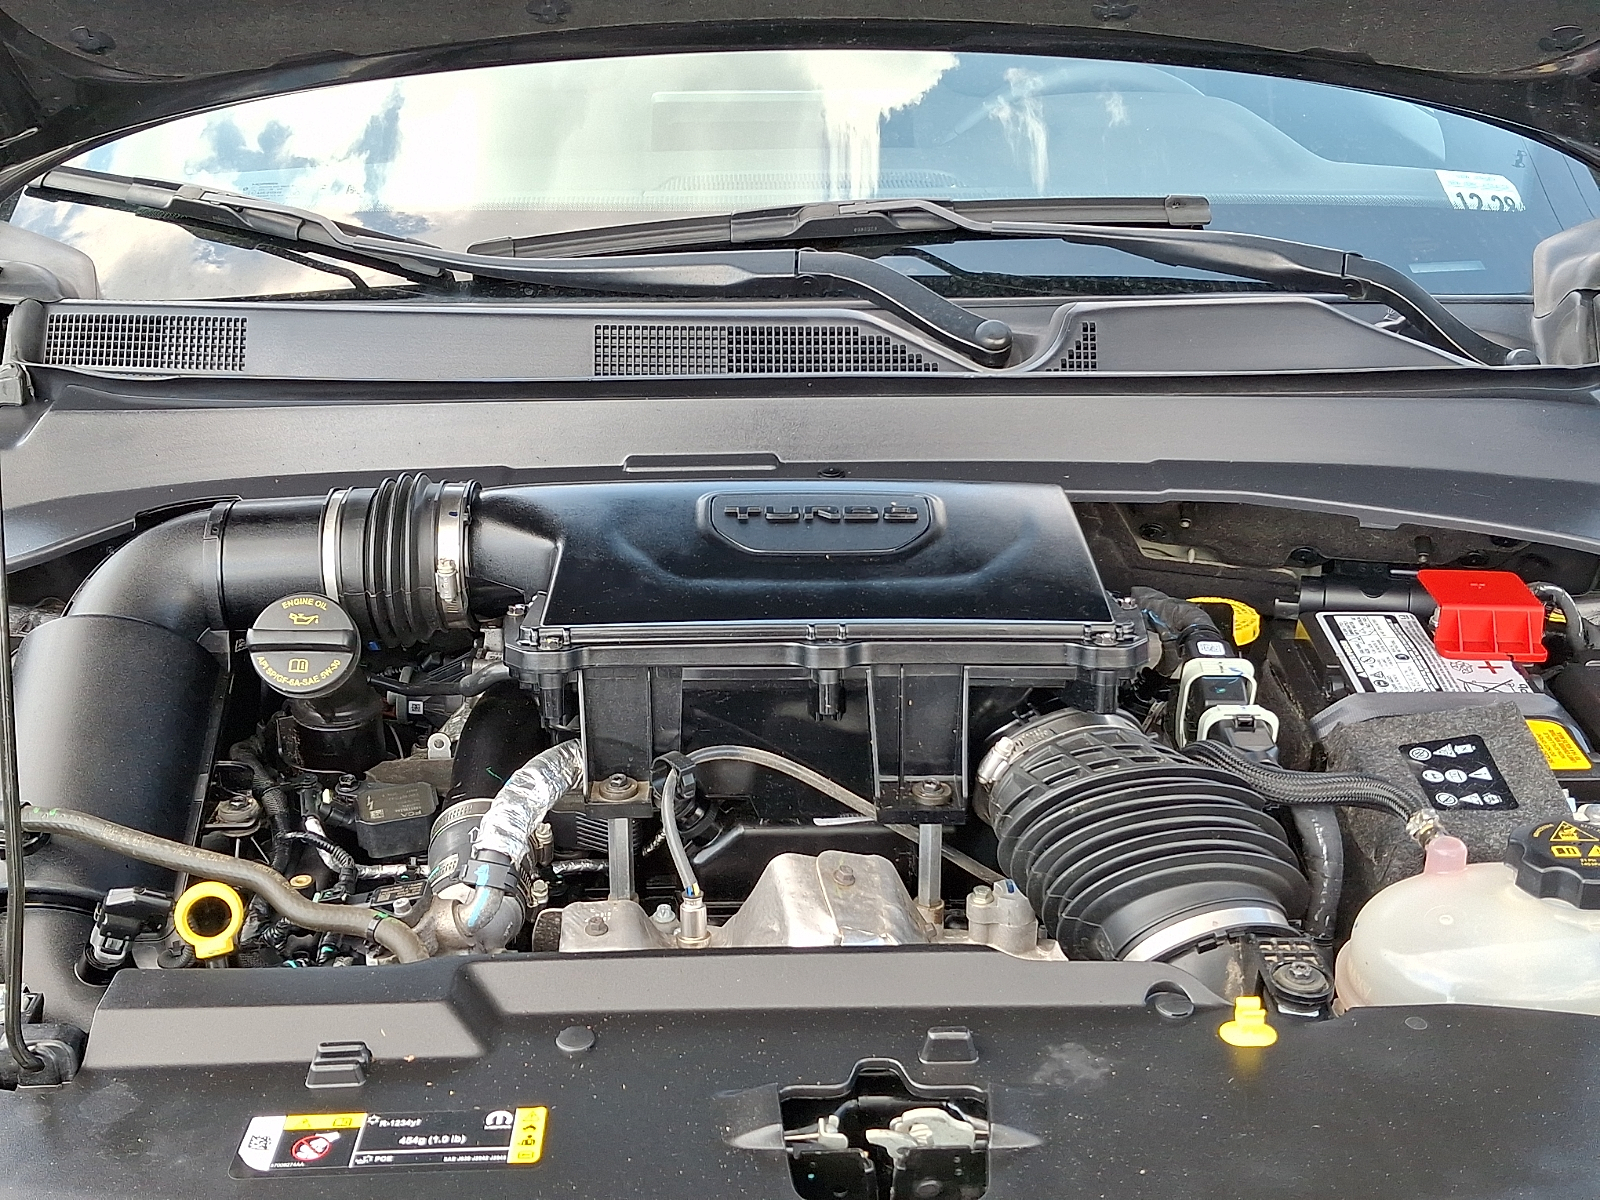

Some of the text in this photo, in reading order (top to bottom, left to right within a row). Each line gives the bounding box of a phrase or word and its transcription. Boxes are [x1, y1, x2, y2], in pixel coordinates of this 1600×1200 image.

[281, 597, 328, 611] ENGINE OIL
[257, 656, 267, 670] API
[320, 659, 341, 679] 5W-30
